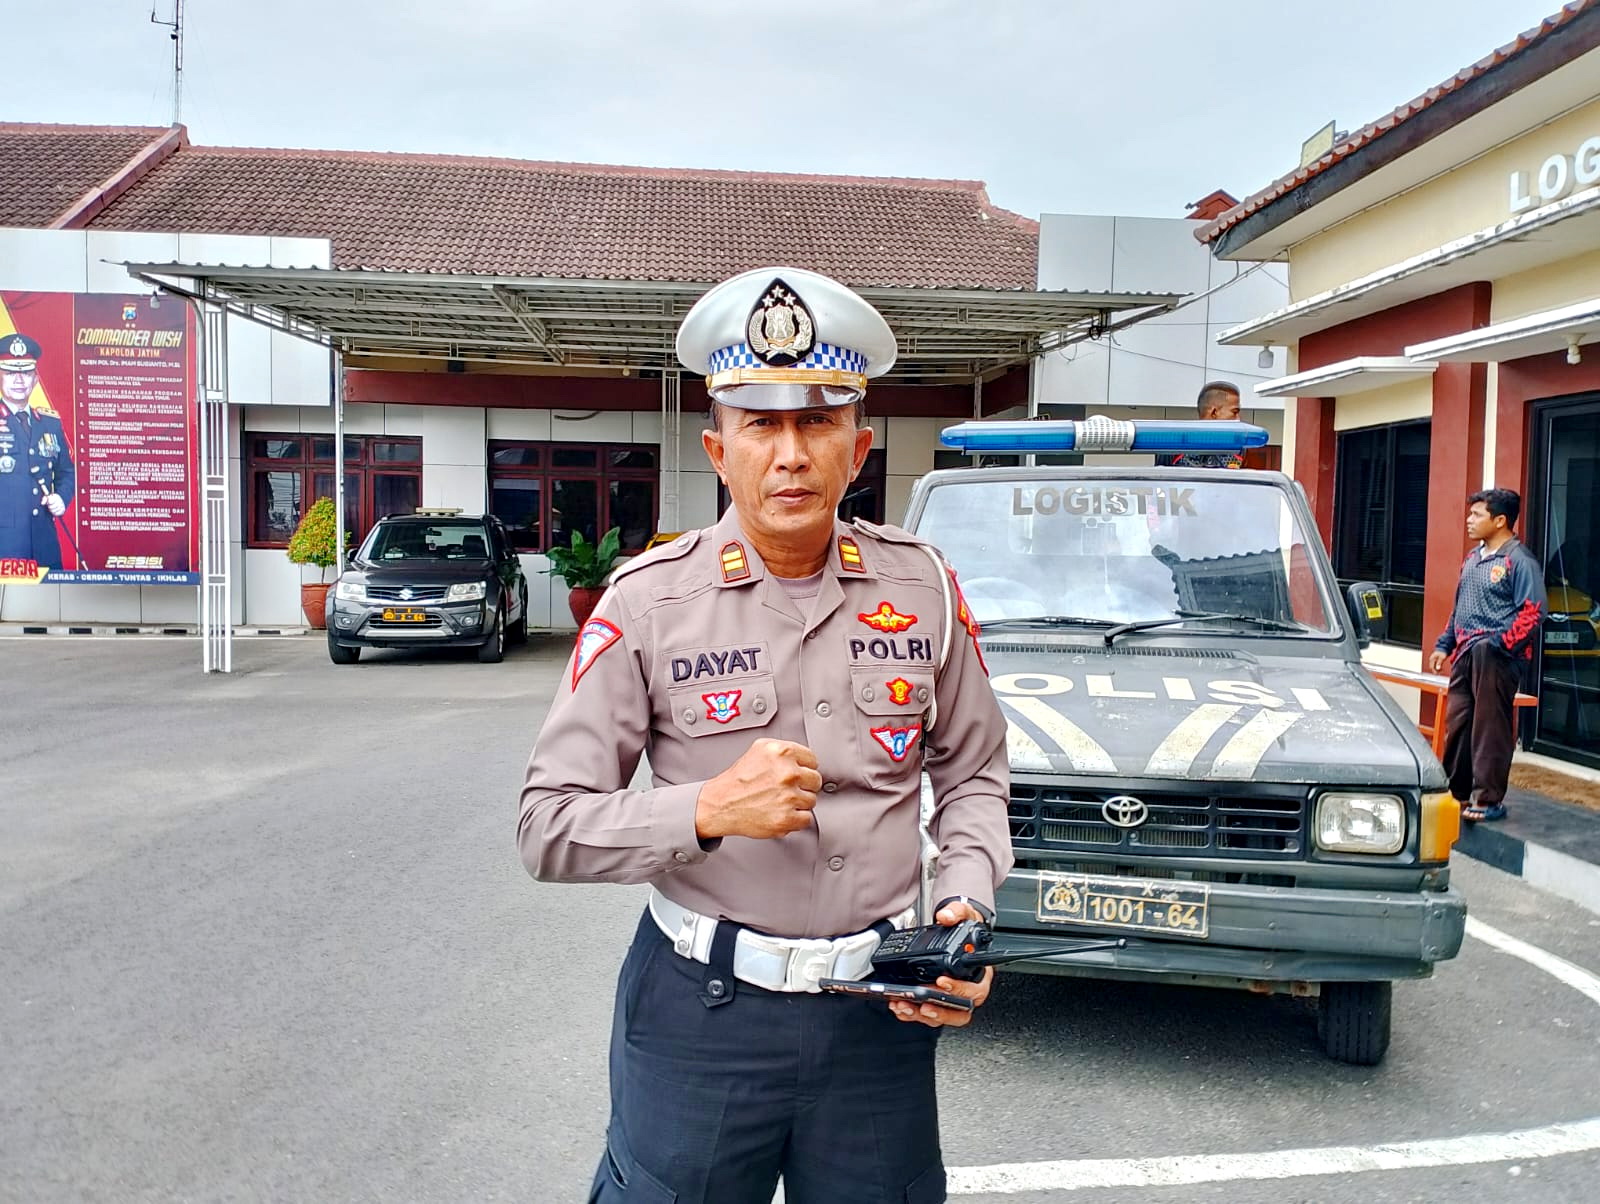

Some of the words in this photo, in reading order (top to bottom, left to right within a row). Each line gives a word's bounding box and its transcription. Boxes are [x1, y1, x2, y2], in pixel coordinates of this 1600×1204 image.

[77, 328, 151, 347] COMMANDER
[151, 330, 183, 348] WISH
[100, 348, 135, 357] KAPOLDA
[137, 348, 161, 357] JATIM
[1012, 486, 1199, 517] LOGISTIK
[48, 573, 75, 581] KERAS
[119, 574, 151, 582] TUNTAS
[849, 638, 932, 661] POLRI
[671, 647, 761, 682] DAYAT
[989, 672, 1332, 711] OLISI
